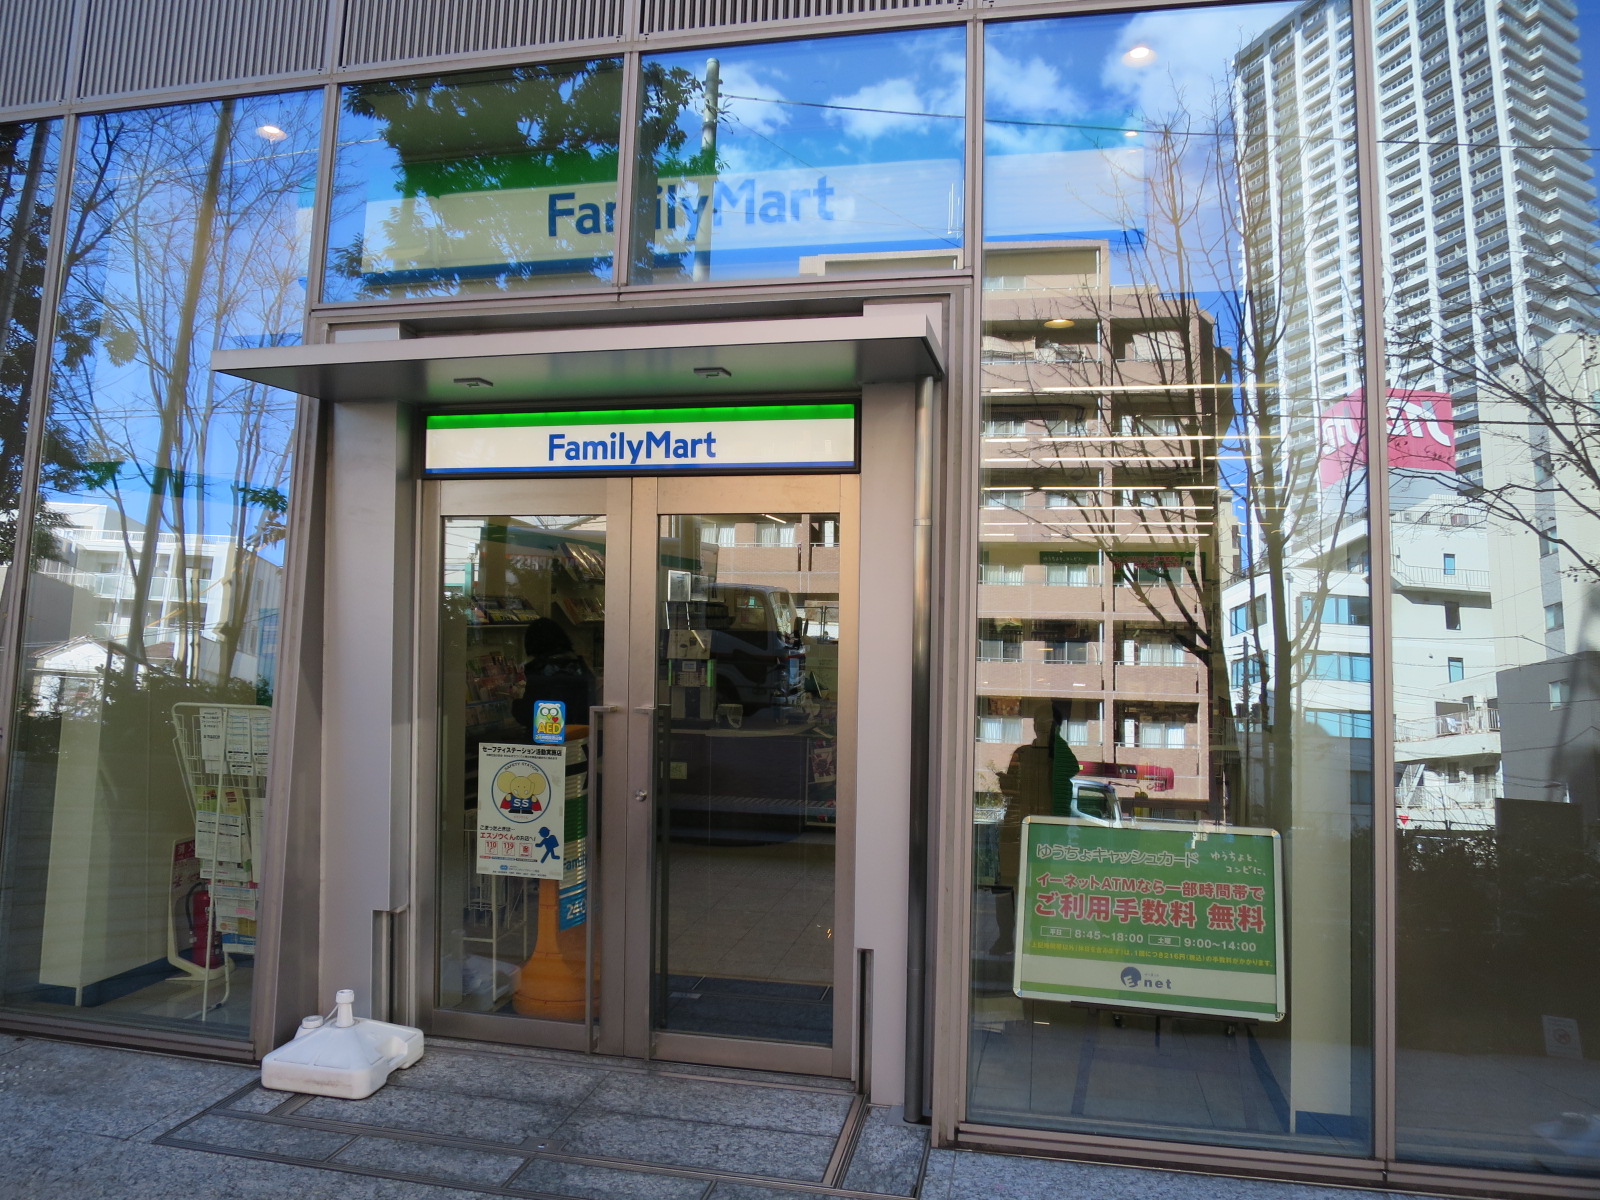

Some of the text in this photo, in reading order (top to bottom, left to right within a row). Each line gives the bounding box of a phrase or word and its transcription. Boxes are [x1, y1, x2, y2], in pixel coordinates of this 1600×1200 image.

[547, 174, 834, 242] FailyMart
[548, 430, 717, 464] FamilyMart
[537, 721, 562, 735] AED
[504, 762, 540, 773] SAFETY STATION
[486, 841, 497, 849] 110
[1036, 843, 1200, 868] ゆうちょキャッシュカード
[1036, 872, 1265, 901] イーネットATMなら一部時間帯で
[1034, 892, 1266, 933] ご利用手数料 無料
[1049, 928, 1063, 937] 平日
